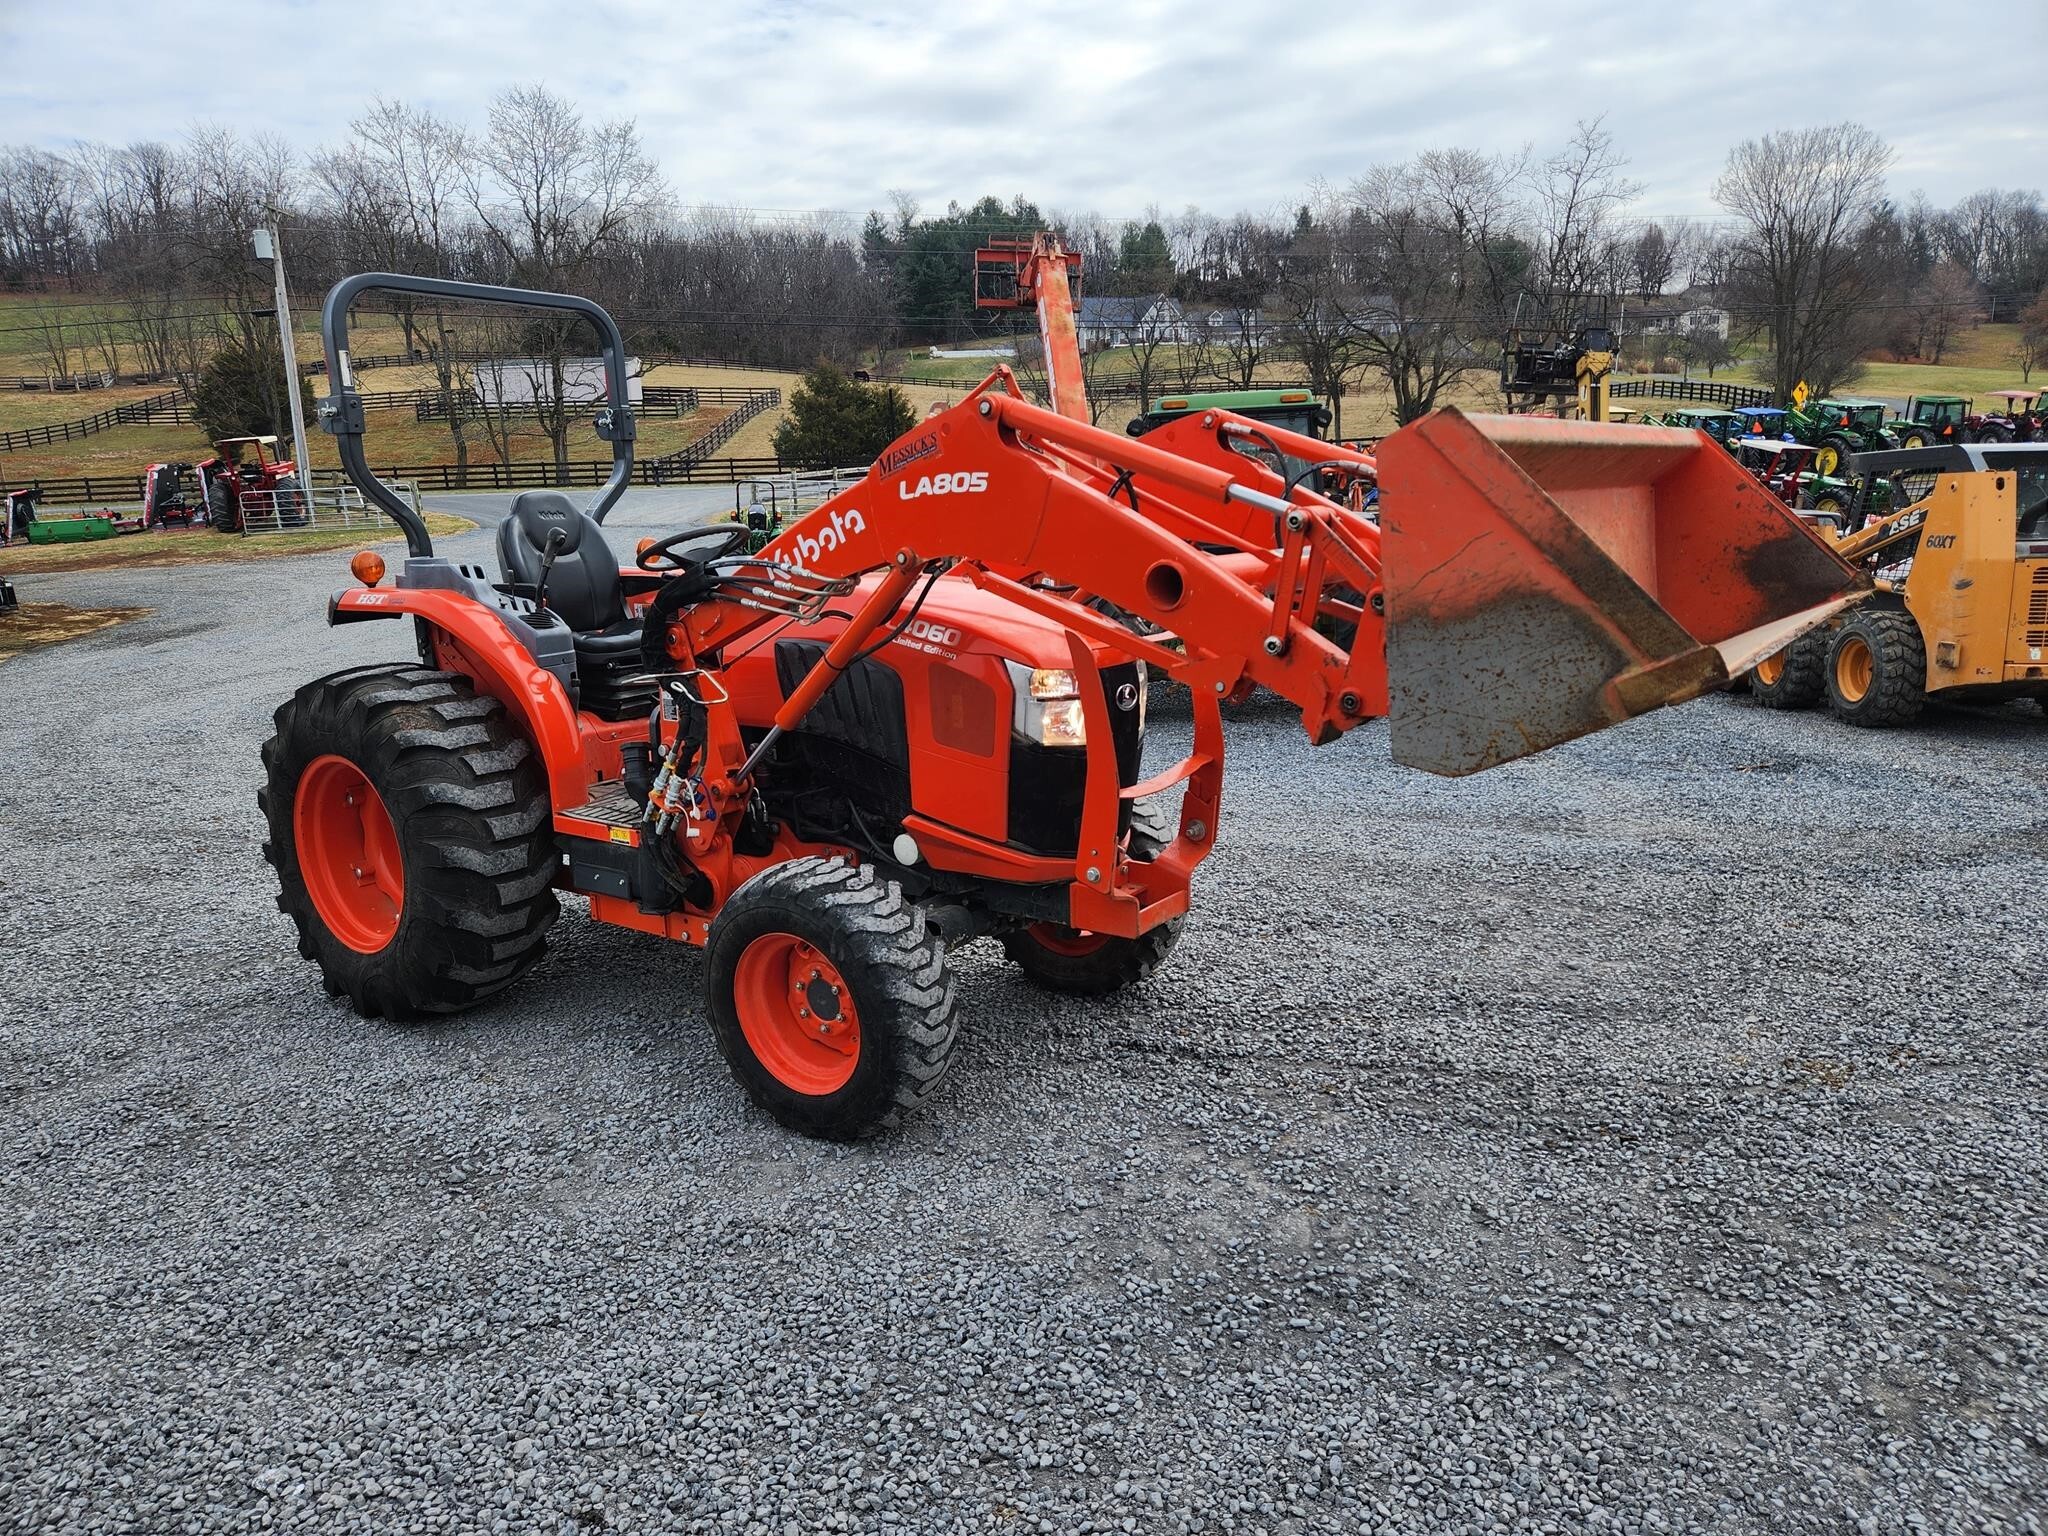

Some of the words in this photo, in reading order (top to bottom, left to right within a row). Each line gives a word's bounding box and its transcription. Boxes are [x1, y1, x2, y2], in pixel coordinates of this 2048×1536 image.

[878, 431, 937, 477] MESSICK'S
[899, 471, 989, 500] LA805
[1926, 534, 1957, 549] 60XT
[355, 593, 389, 605] HST
[892, 636, 923, 651] Limited
[923, 644, 957, 660] Edition
